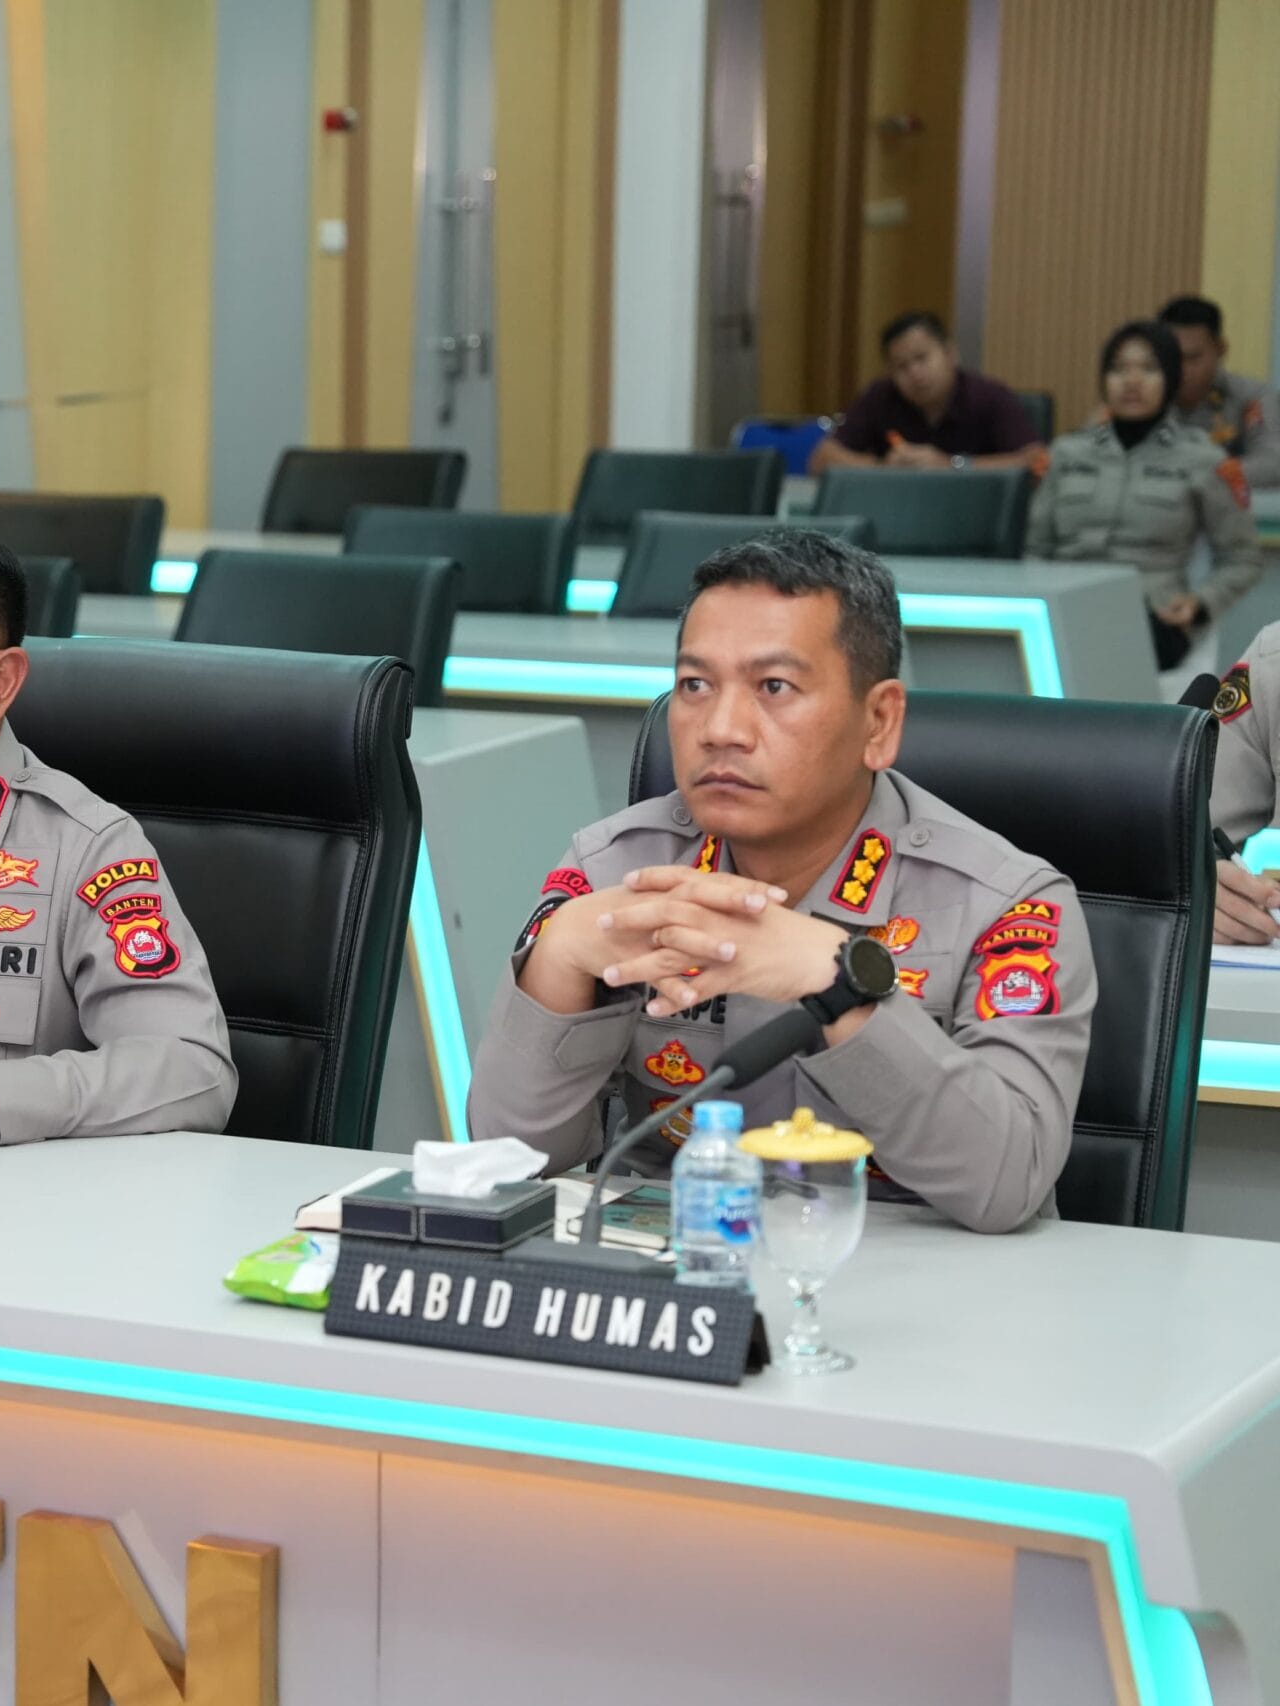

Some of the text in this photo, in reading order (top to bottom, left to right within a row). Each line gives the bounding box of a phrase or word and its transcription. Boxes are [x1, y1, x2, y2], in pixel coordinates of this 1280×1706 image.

[83, 861, 153, 900] POLDA
[549, 870, 592, 895] PELOP
[106, 898, 154, 916] BANTEN
[355, 1263, 717, 1357] KABID HUMAS
